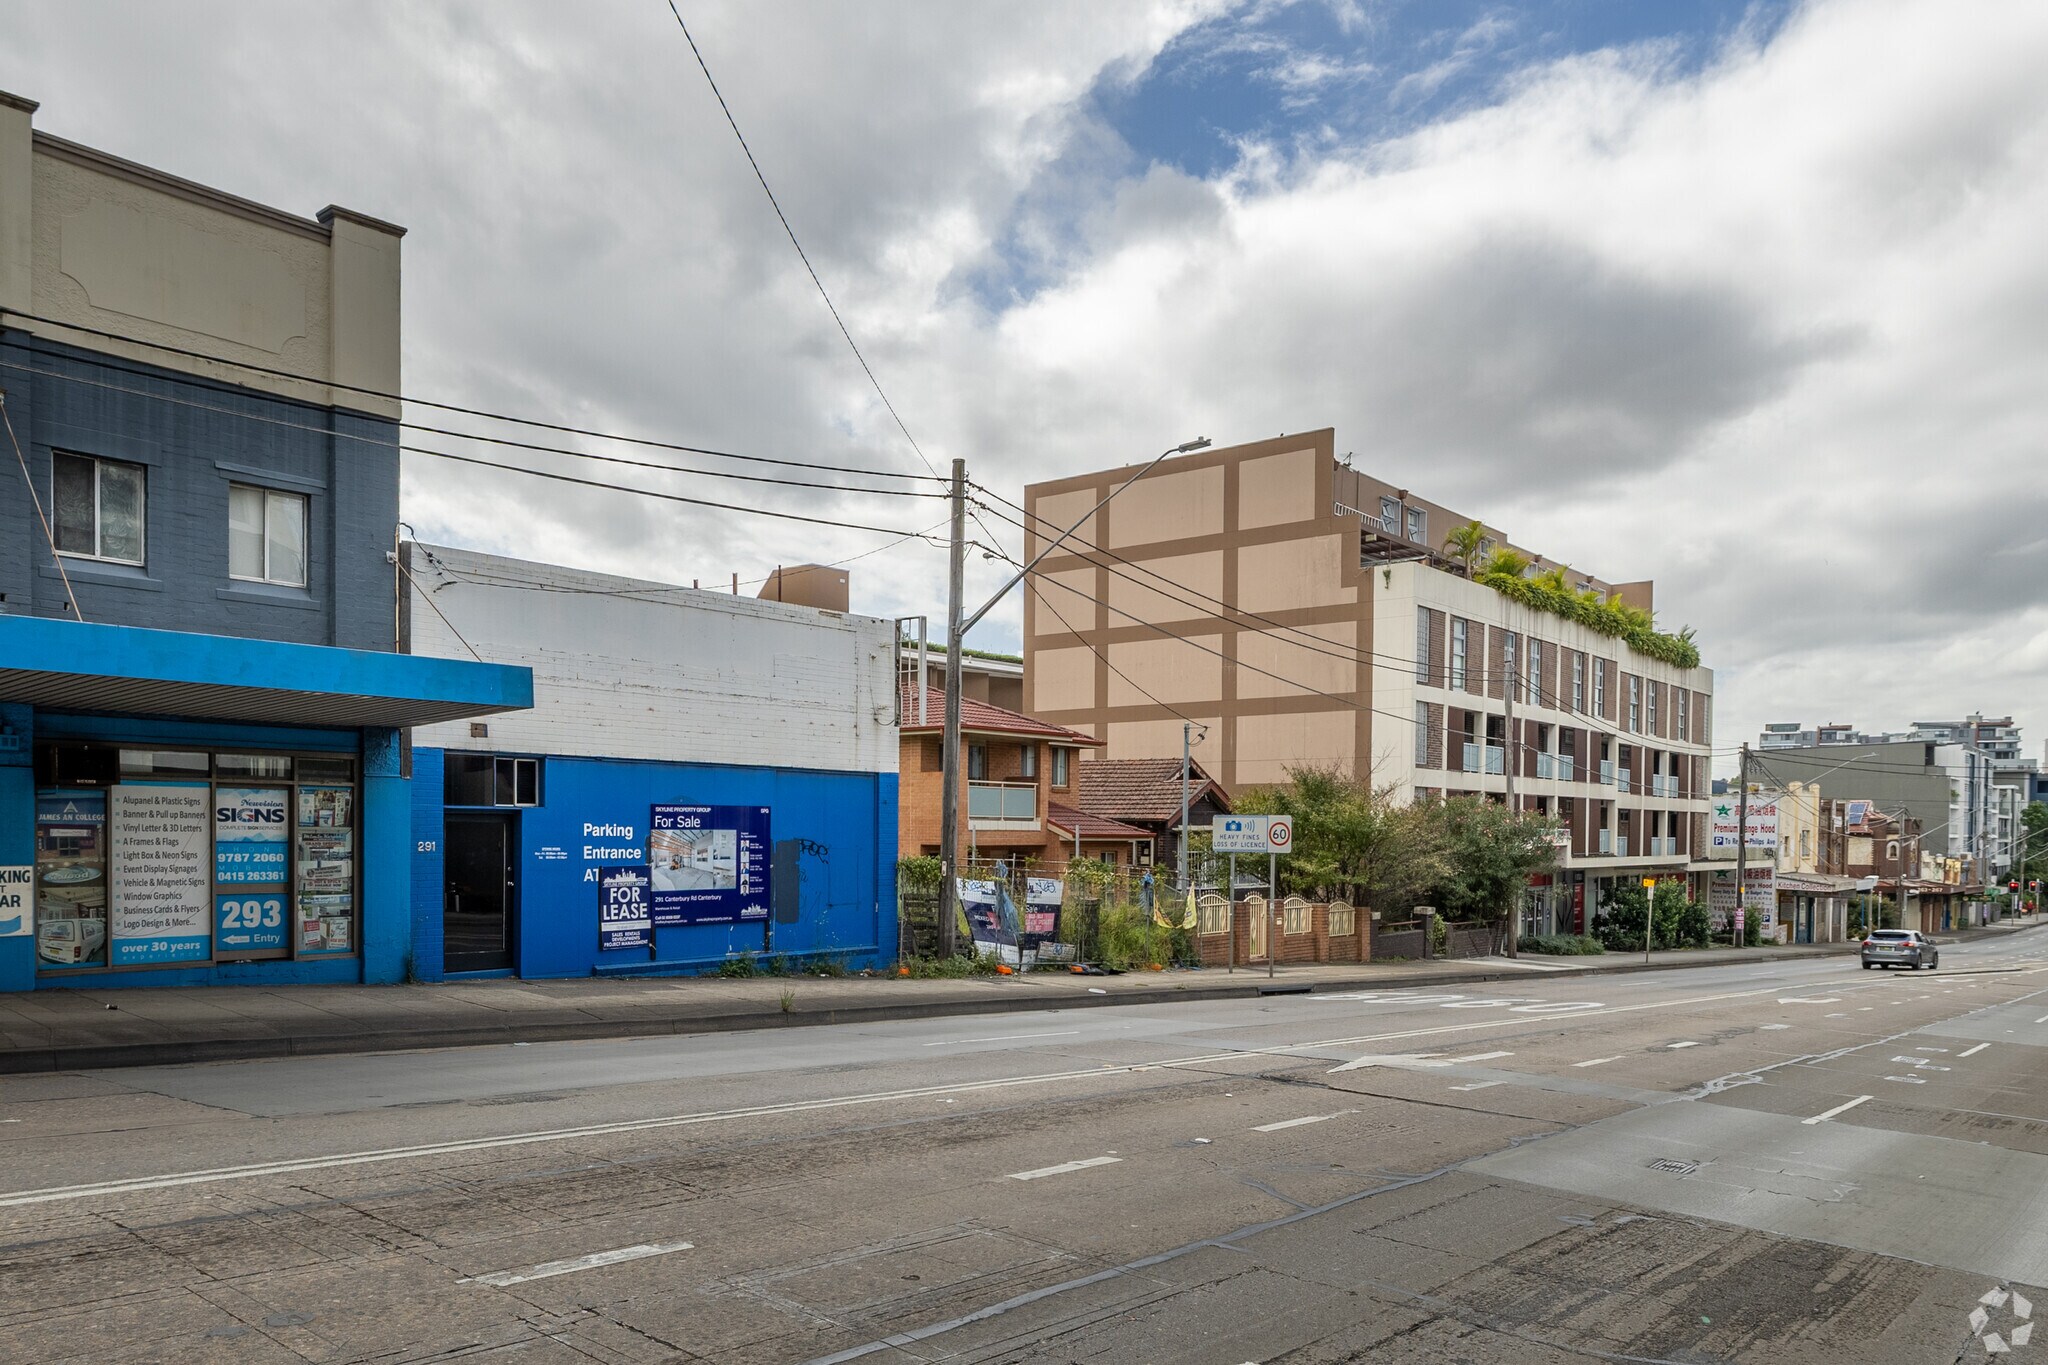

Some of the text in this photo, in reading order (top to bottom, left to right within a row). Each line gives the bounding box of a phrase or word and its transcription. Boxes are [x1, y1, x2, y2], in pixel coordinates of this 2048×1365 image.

[123, 796, 200, 807] Alupanel & Plastic Signs
[38, 813, 105, 822] JAMES AN COLLEGE
[123, 810, 206, 820] Banner & Pull up Banners
[216, 807, 285, 823] SIGNS
[654, 815, 701, 828] For Sale
[123, 824, 202, 834] Vinyl Letter & 3D Letters
[583, 823, 633, 840] Parking
[1714, 823, 1738, 833] Premium
[1760, 823, 1775, 833] Hood
[1273, 828, 1287, 840] 60
[123, 838, 179, 847] A Frames & Flags
[1725, 837, 1731, 845] To
[417, 841, 436, 852] 291
[123, 851, 140, 861] Light
[154, 851, 160, 859] &
[181, 852, 198, 860] Signs
[583, 845, 642, 859] Entrance
[217, 853, 284, 862] 9787 2060
[124, 864, 197, 874] Event Display Signages
[218, 872, 284, 880] 0415 263361
[124, 878, 205, 888] Vehicle & Magnetic Signs
[1777, 881, 1832, 891] Kitchen Collection
[124, 892, 182, 901] Window Graphics
[609, 886, 641, 903] FOR
[698, 894, 722, 902] Canterbury
[124, 906, 153, 914] Business
[154, 905, 172, 914] Cards
[180, 904, 200, 914] Flyers
[603, 903, 648, 921] LEASE
[1025, 904, 1038, 913] Sale
[222, 900, 281, 929] 293
[124, 920, 140, 930] Logo
[142, 920, 164, 928] Design
[254, 934, 280, 944] Entry
[122, 942, 200, 953] over 30 years
